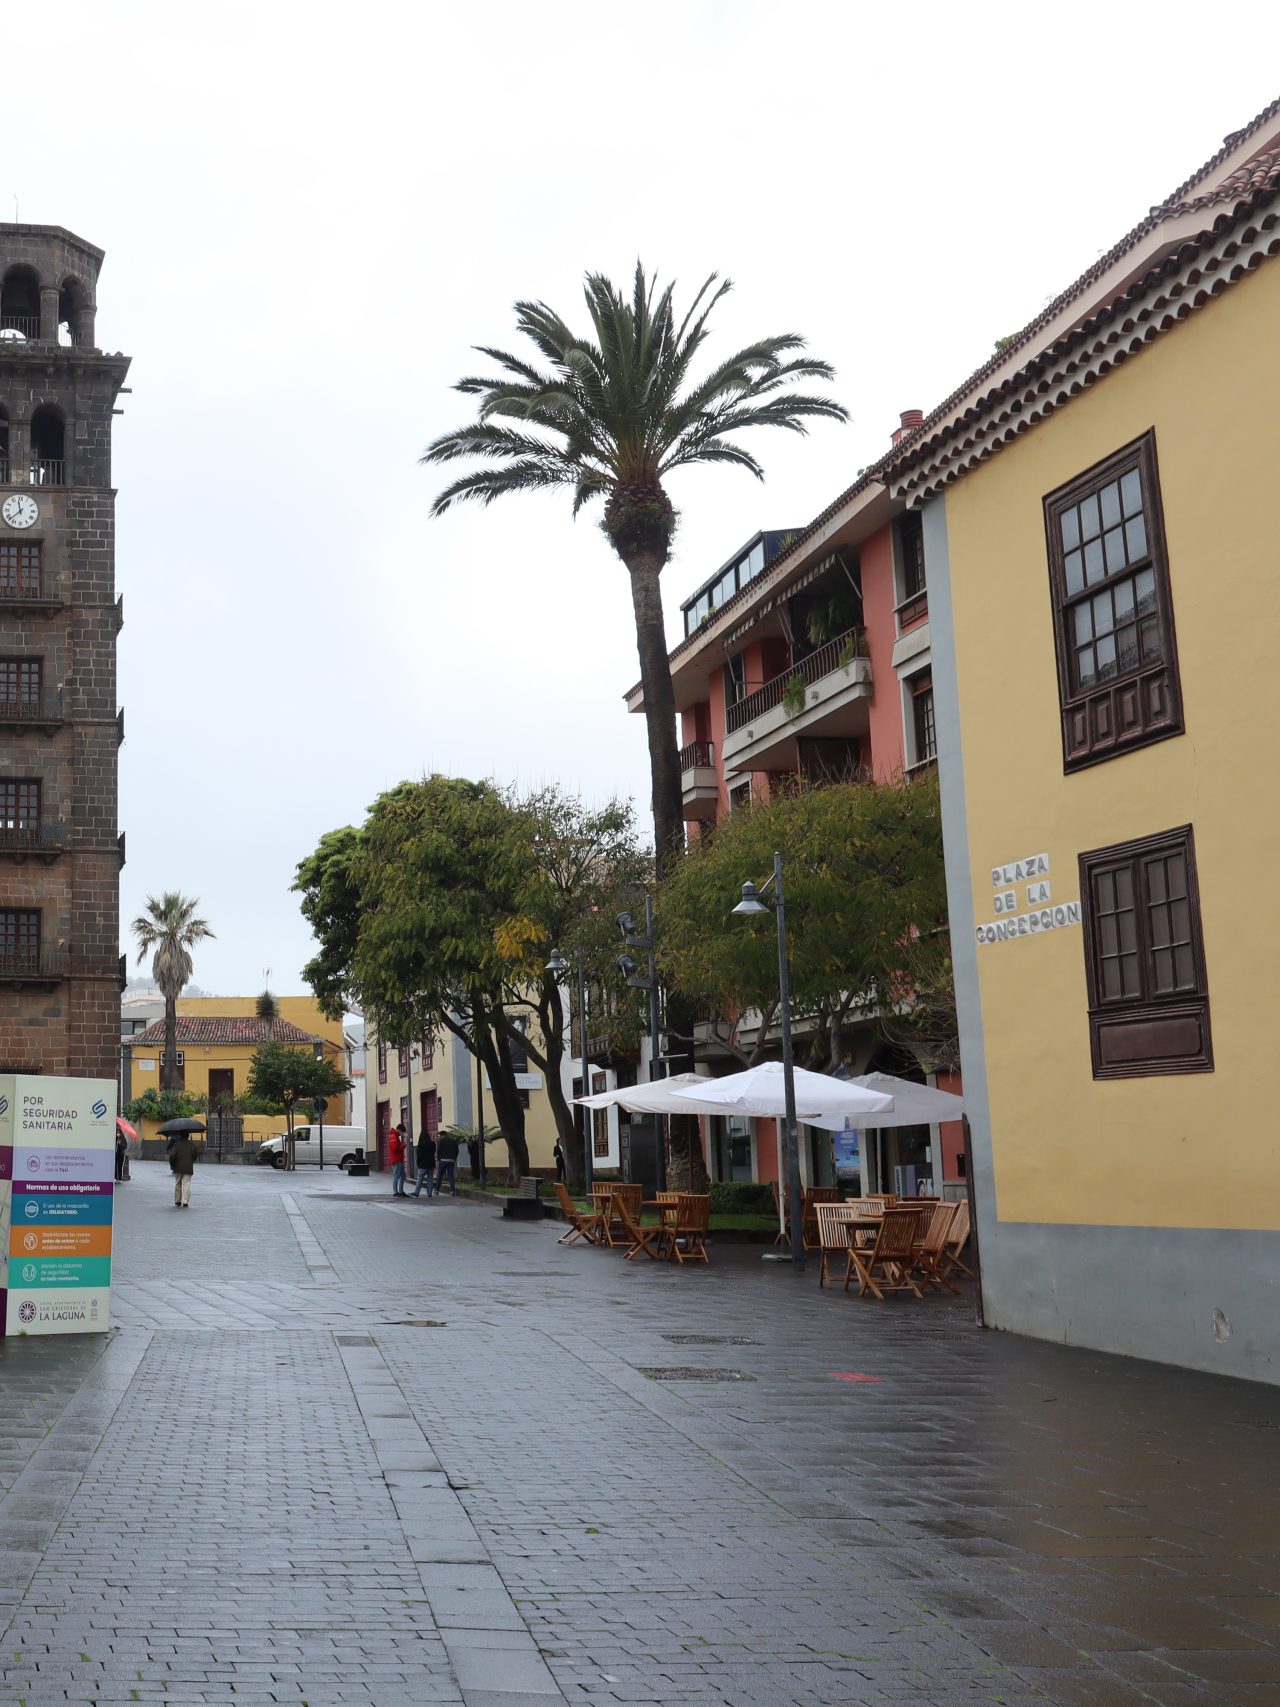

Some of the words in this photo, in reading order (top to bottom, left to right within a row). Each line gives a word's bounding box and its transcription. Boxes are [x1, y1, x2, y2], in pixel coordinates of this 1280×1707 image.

[992, 856, 1048, 886] PLAZA
[994, 892, 1016, 912] DE
[1027, 884, 1049, 904] LA
[976, 902, 1081, 942] CONCEPCION
[23, 1096, 43, 1105] POR
[23, 1108, 78, 1118] SEGURIDAD
[22, 1120, 73, 1130] SANITARIA
[70, 1184, 100, 1192] obligatorio
[53, 1312, 86, 1320] LAGUNA
